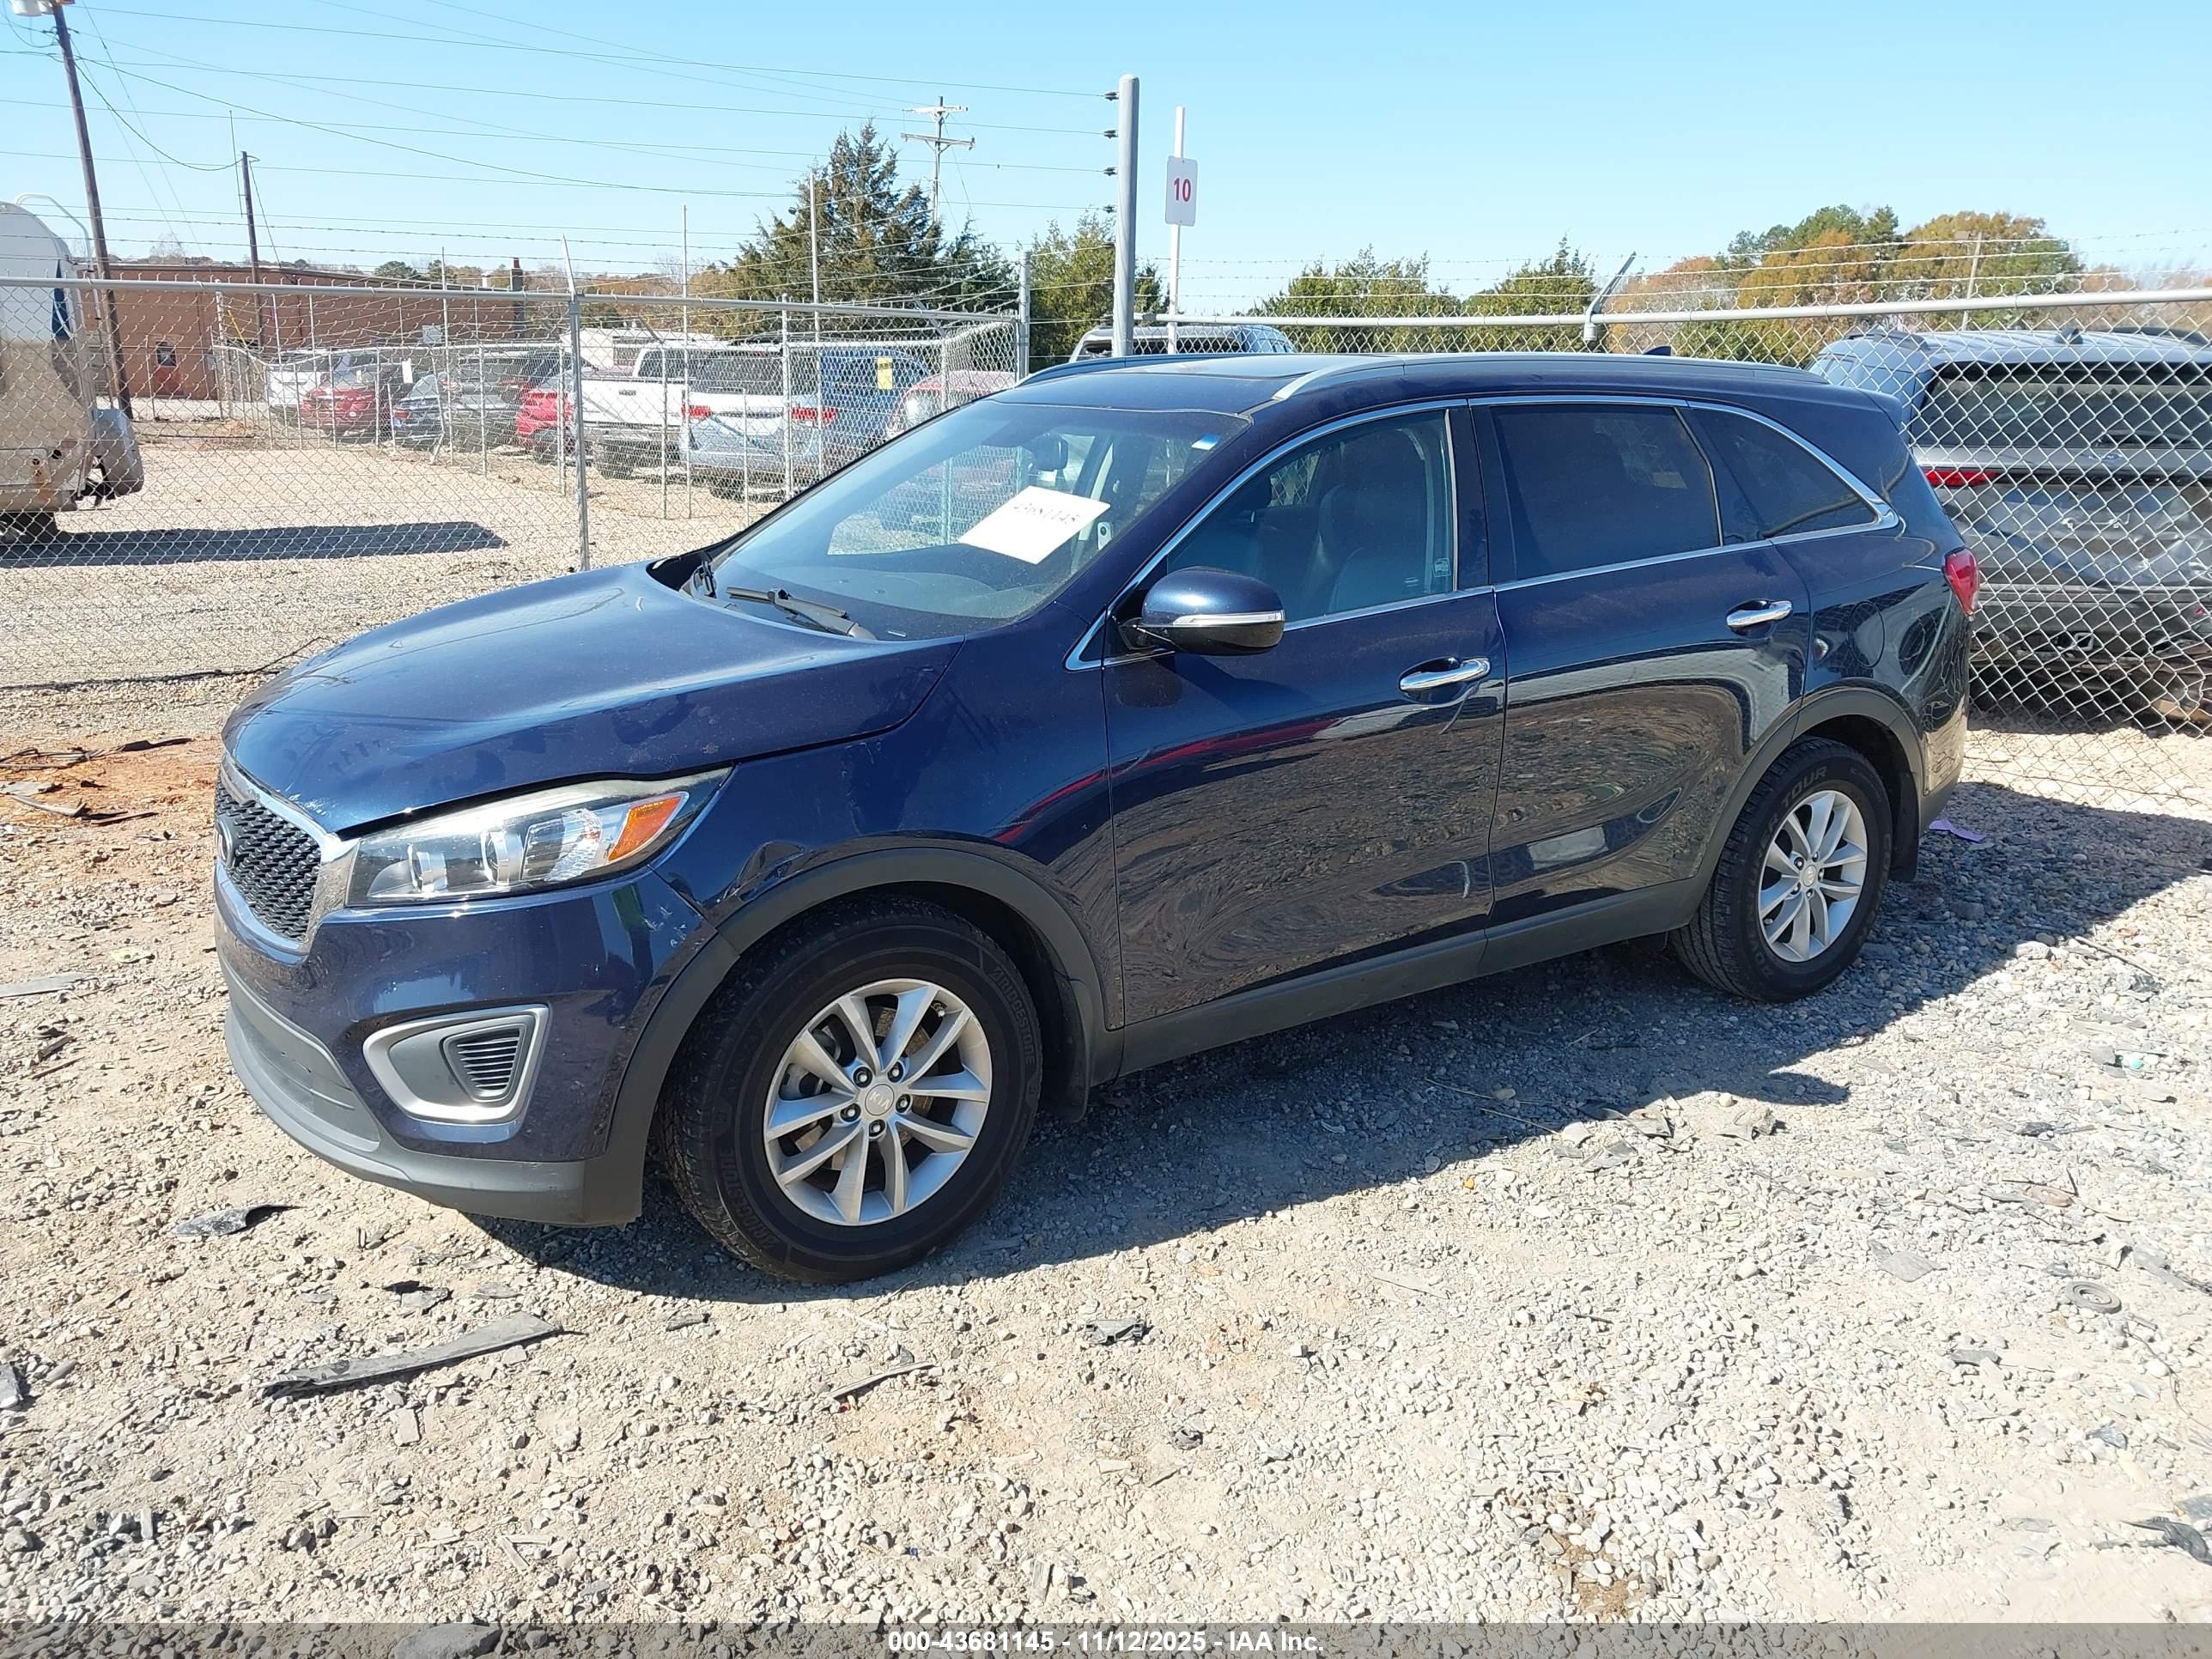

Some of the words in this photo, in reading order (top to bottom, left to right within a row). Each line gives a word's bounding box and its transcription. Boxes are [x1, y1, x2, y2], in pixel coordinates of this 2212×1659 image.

[1173, 177, 1192, 203] 10
[1780, 766, 1827, 808] TOUR
[988, 966, 1036, 1066] BRIDGESTONE
[869, 1091, 890, 1110] KIA
